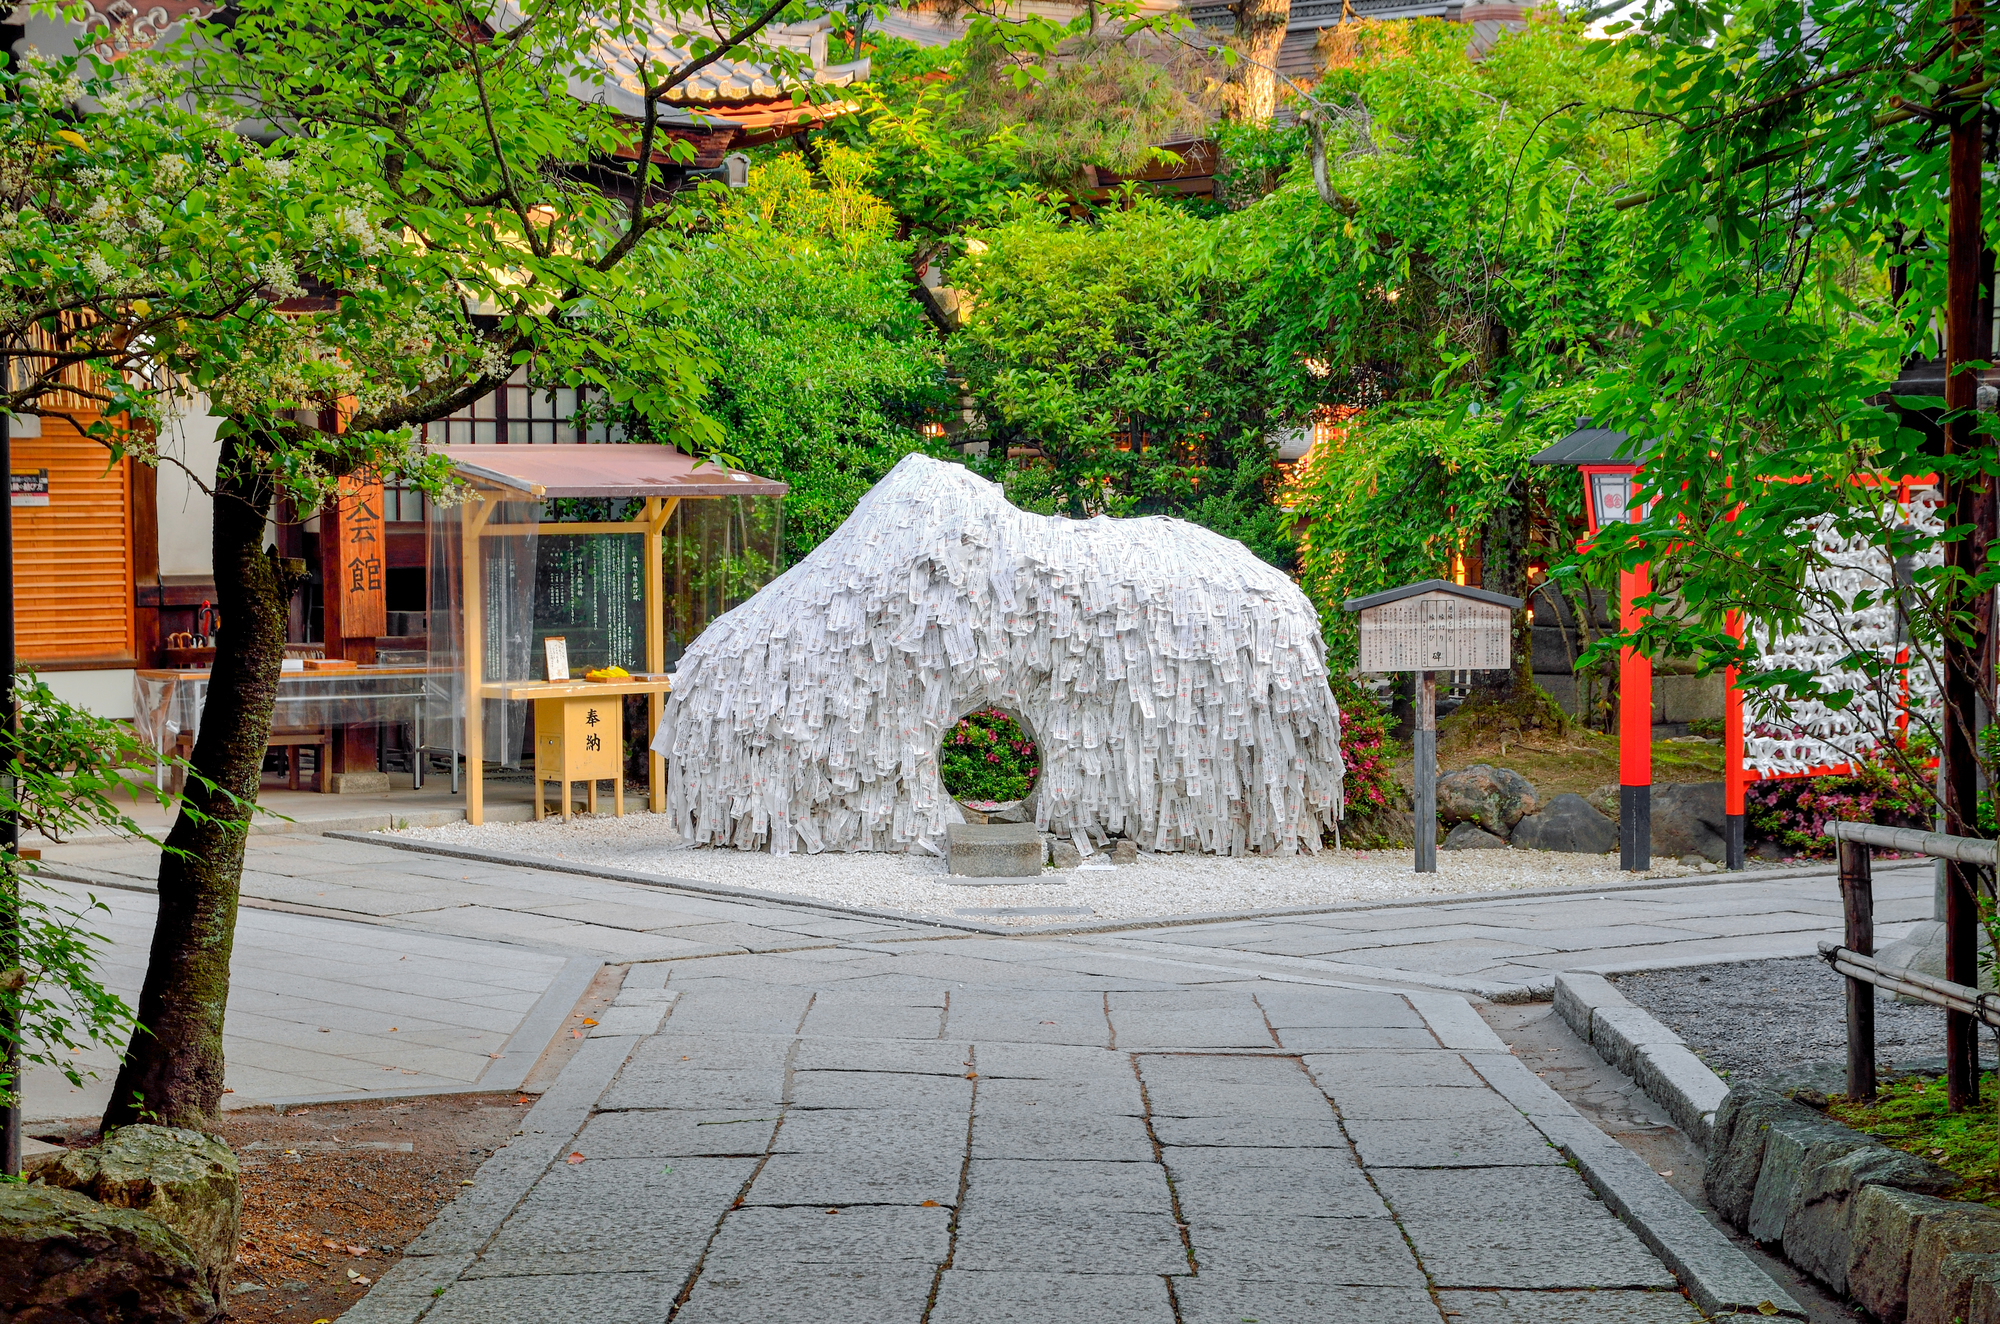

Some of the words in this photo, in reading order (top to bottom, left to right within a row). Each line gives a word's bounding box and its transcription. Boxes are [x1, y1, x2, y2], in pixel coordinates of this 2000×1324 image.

[10, 482, 44, 492] 縁の結び方
[585, 708, 601, 752] 奉納
